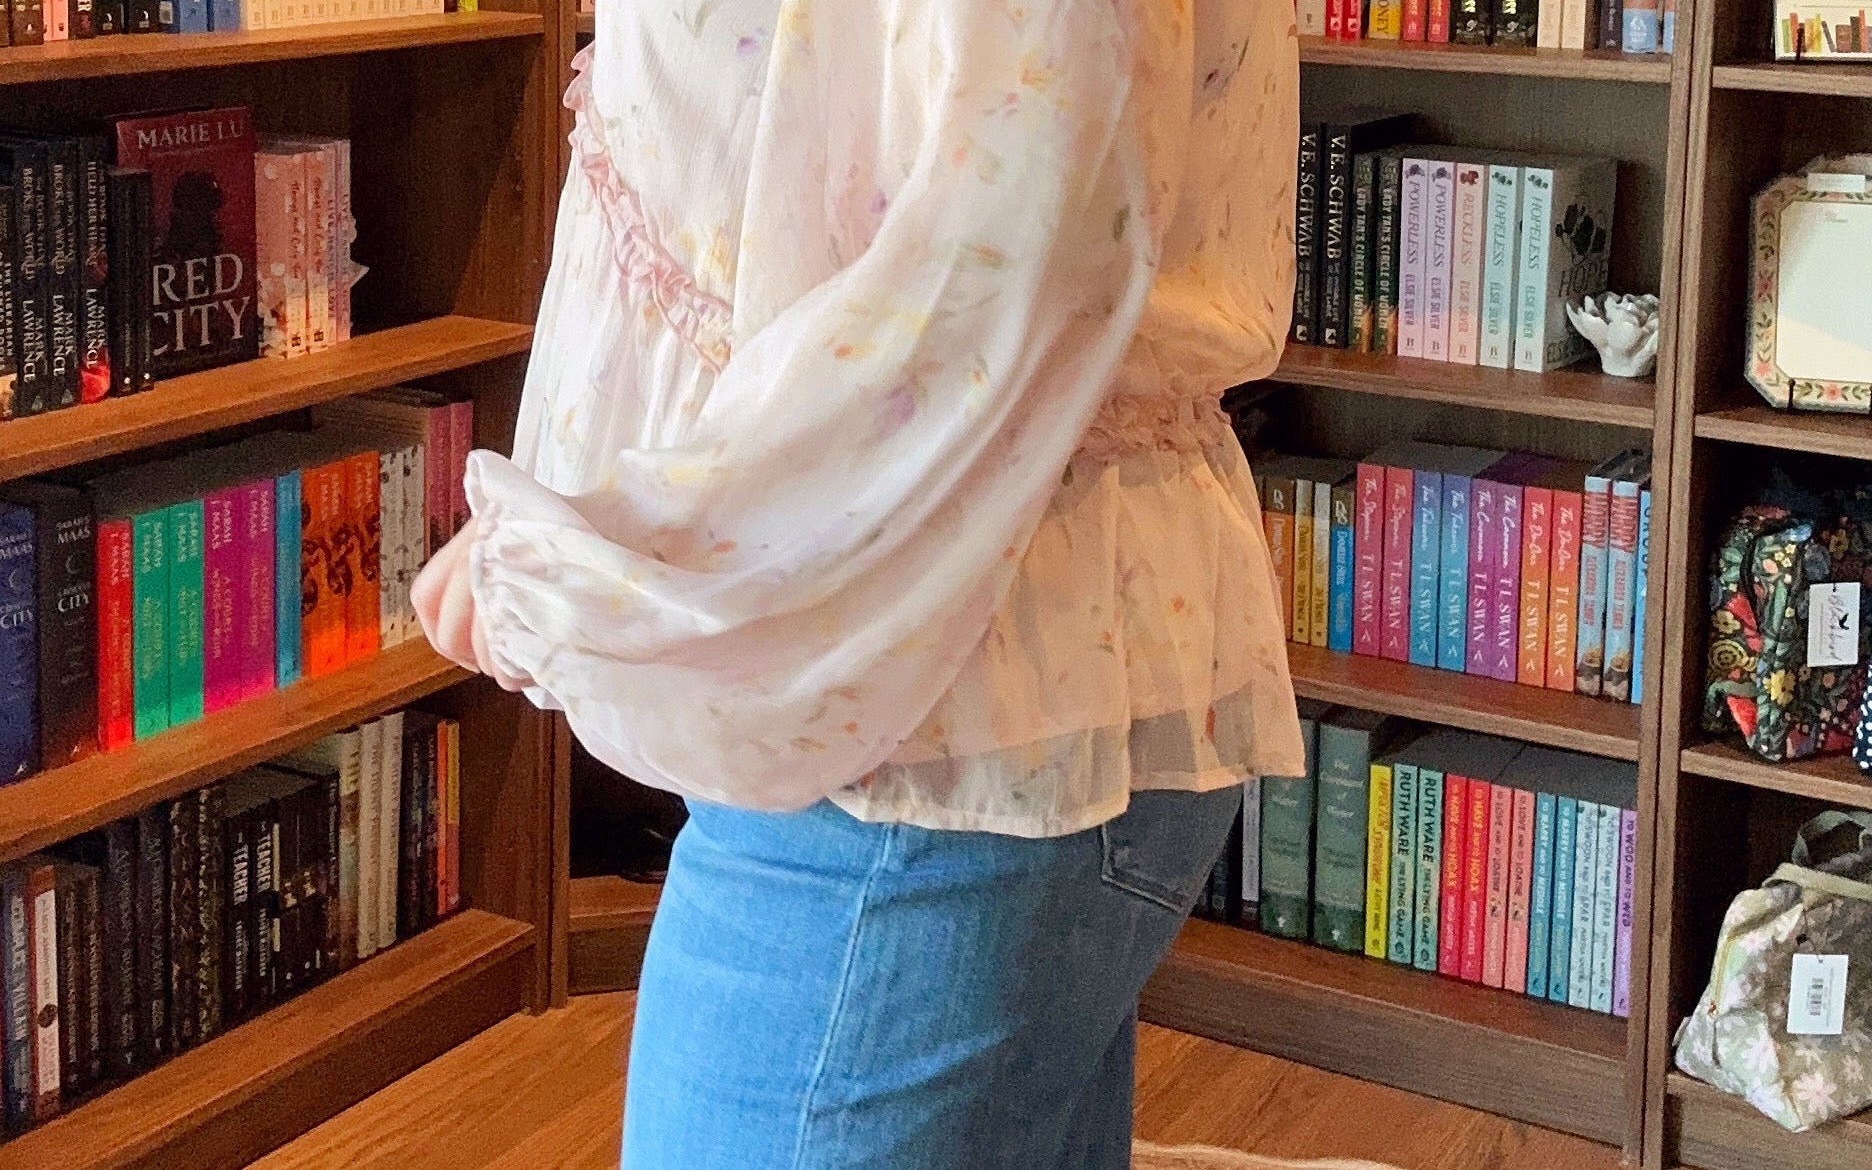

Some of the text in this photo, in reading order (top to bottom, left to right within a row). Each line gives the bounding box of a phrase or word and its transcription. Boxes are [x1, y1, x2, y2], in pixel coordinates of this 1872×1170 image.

[137, 119, 244, 150] MARIE LU
[1297, 171, 1316, 258] SCHWAB
[1326, 174, 1345, 260] SCHWAB
[1527, 196, 1544, 270] HOPELESS
[152, 253, 245, 306] RED
[1403, 180, 1421, 327] POWERLESS ELSIE SILVER
[1429, 184, 1448, 330] POWERLESS ELSIE SILVER
[1457, 192, 1475, 334] RECKLESS ELSIE SILVER
[1488, 193, 1508, 335] HOPELESS ELSIE SILVER
[22, 299, 36, 383] LAWRENCE
[52, 294, 66, 377] LAWRENCE
[63, 311, 75, 356] MARK
[85, 288, 99, 370] LAWRENCE
[1523, 310, 1535, 339] SILVER
[0, 608, 35, 629] CITY
[57, 593, 90, 613] CITY
[1360, 580, 1374, 623] SWAN
[1418, 588, 1432, 633] SWAN
[1472, 597, 1487, 642] SWAN
[1497, 604, 1511, 647] SWAN
[1525, 606, 1539, 652] SWAN
[1553, 612, 1568, 658] SWAN
[1397, 770, 1412, 856] RUTH WARE
[1422, 777, 1437, 864] RUTH WARE
[233, 843, 250, 906] TEACHER
[256, 833, 272, 894] TEACHER
[1625, 833, 1636, 863] WOO
[1621, 901, 1633, 928] WED
